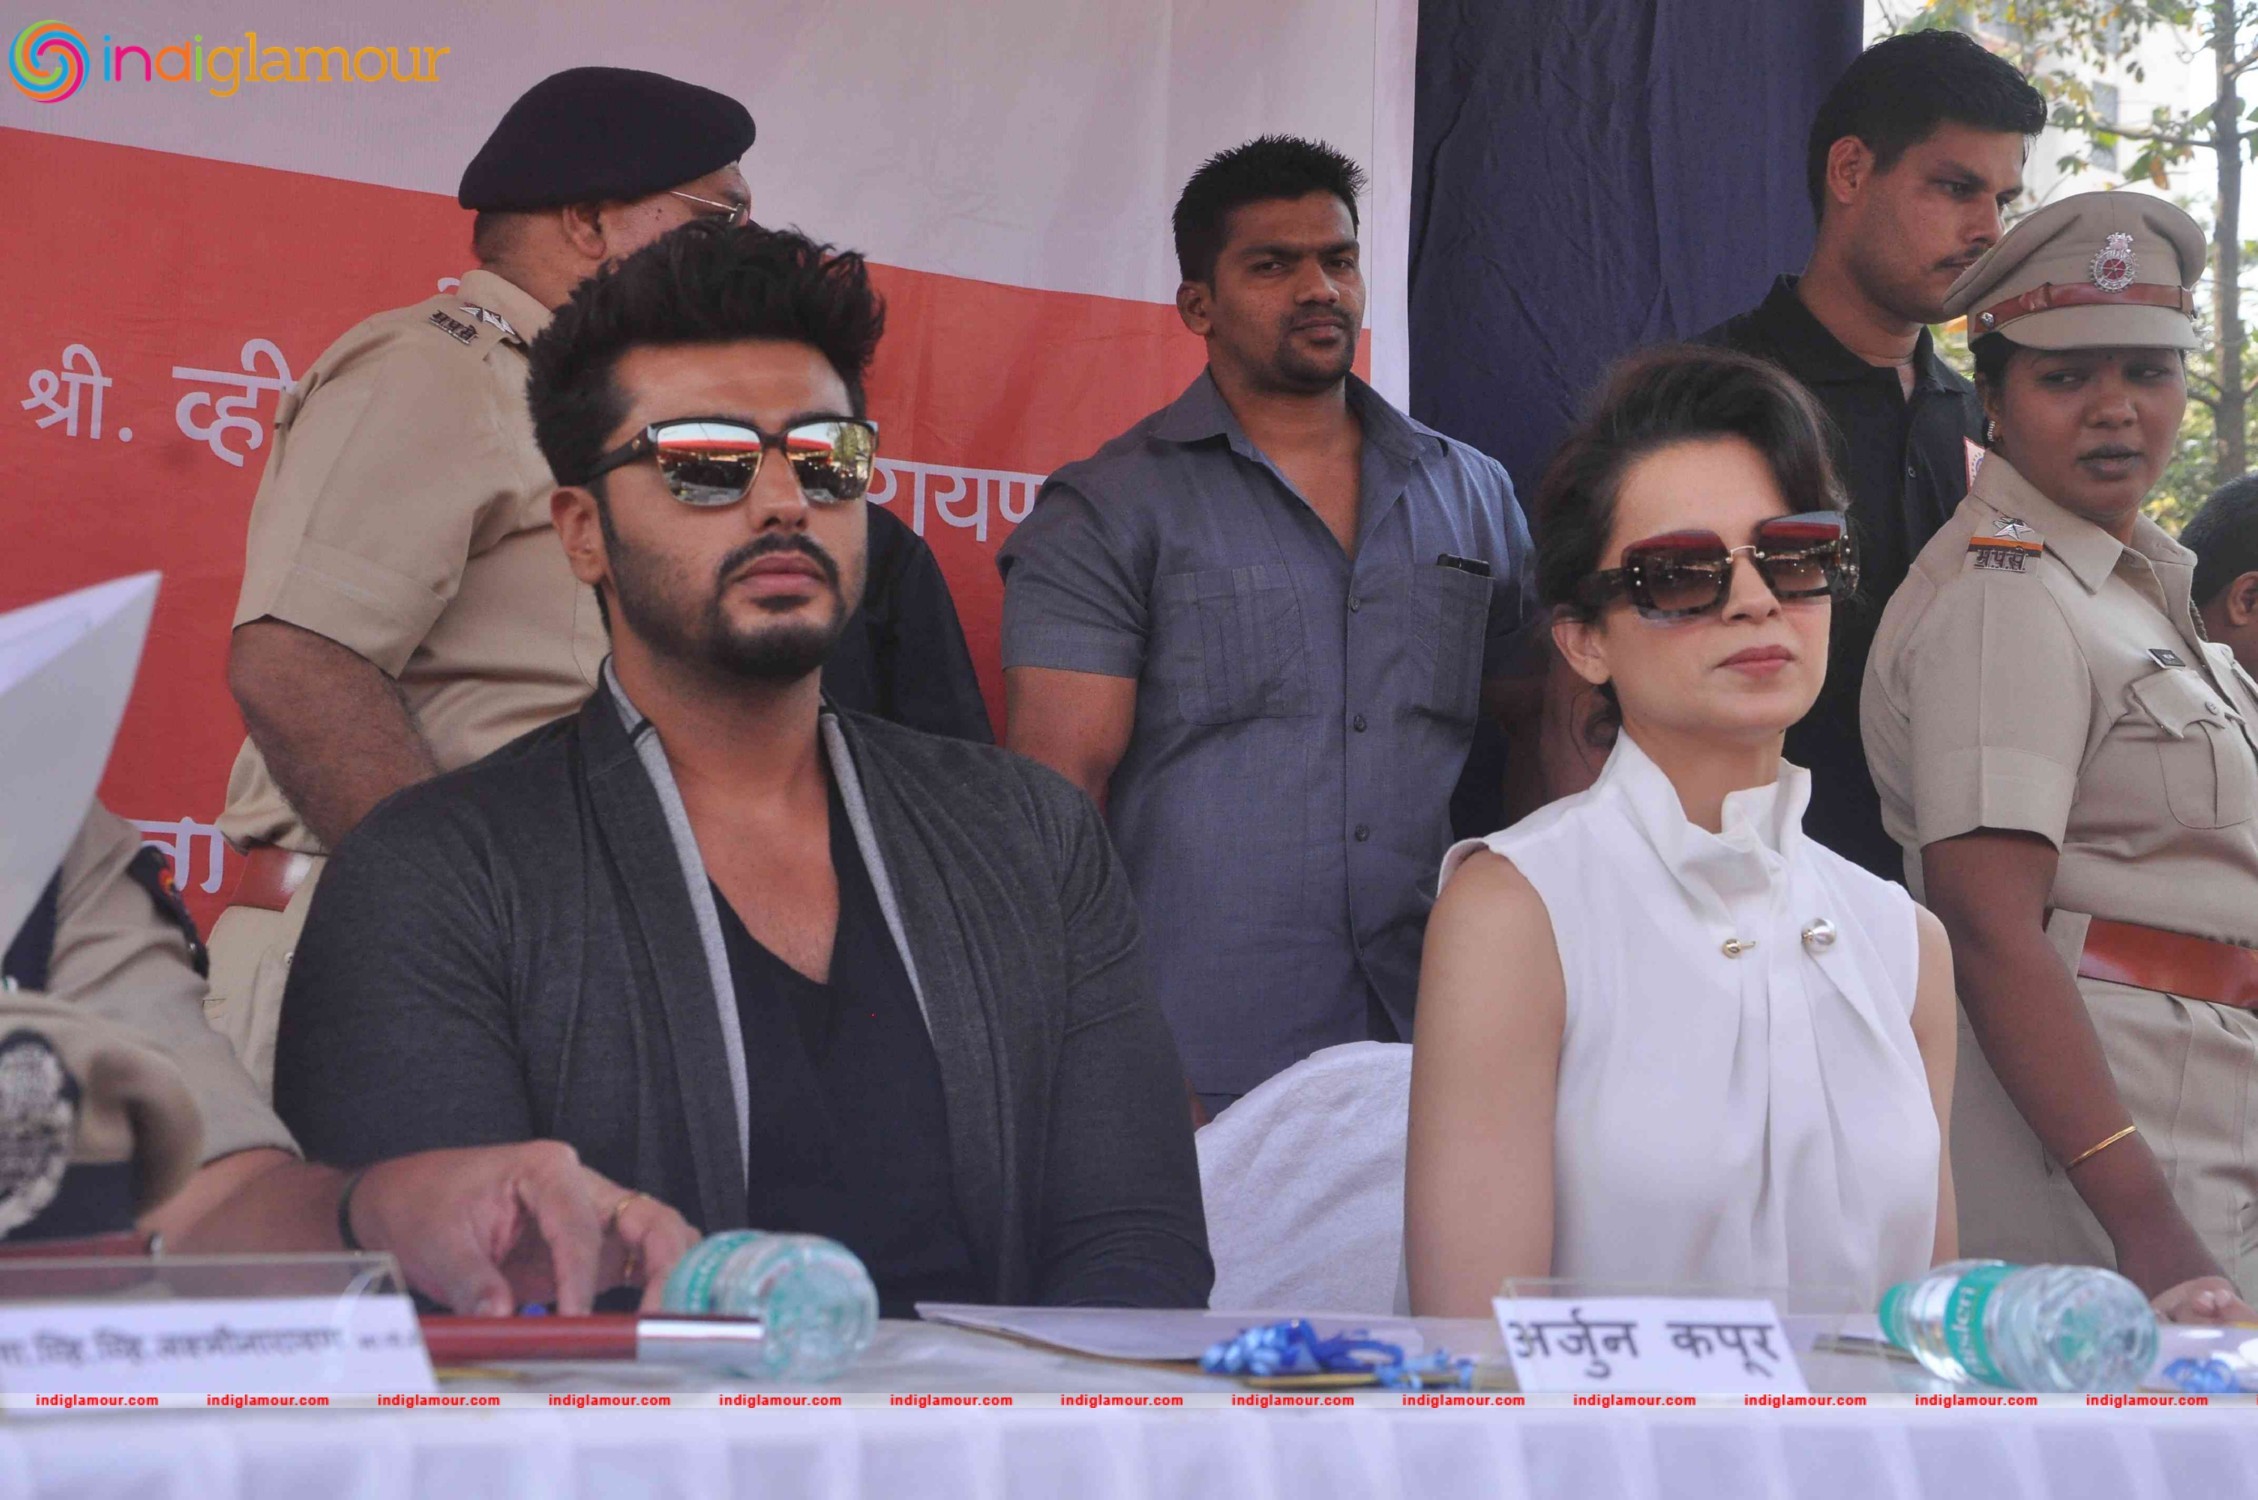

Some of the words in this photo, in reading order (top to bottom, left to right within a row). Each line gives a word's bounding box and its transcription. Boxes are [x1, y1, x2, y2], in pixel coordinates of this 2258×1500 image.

[20, 343, 133, 440] श्री.
[1507, 1307, 1640, 1379] अर्जुन
[1664, 1319, 1780, 1379] कपूर
